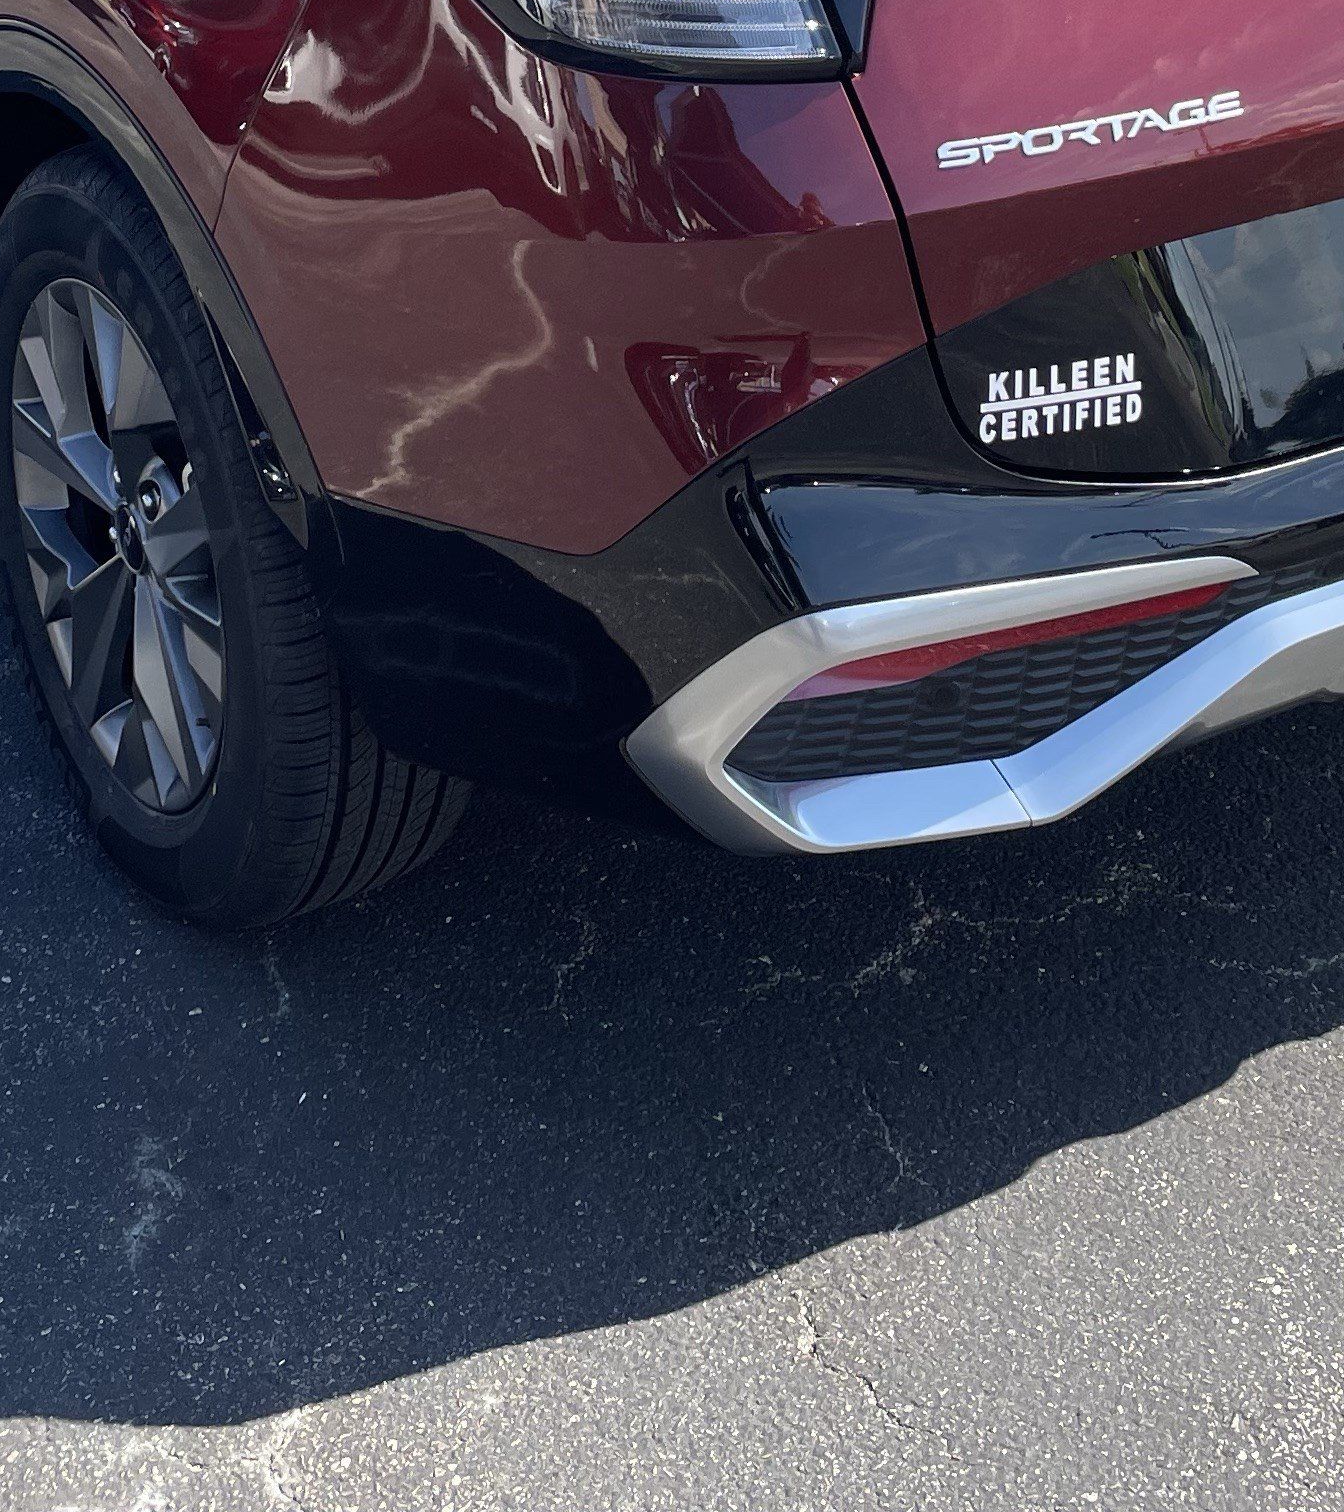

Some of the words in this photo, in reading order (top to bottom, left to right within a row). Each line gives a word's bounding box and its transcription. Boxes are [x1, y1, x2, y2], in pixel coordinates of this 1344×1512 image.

[936, 90, 1245, 169] SPORTAGE
[988, 353, 1135, 402] KILLEEN
[979, 393, 1143, 444] CERTIFIED
